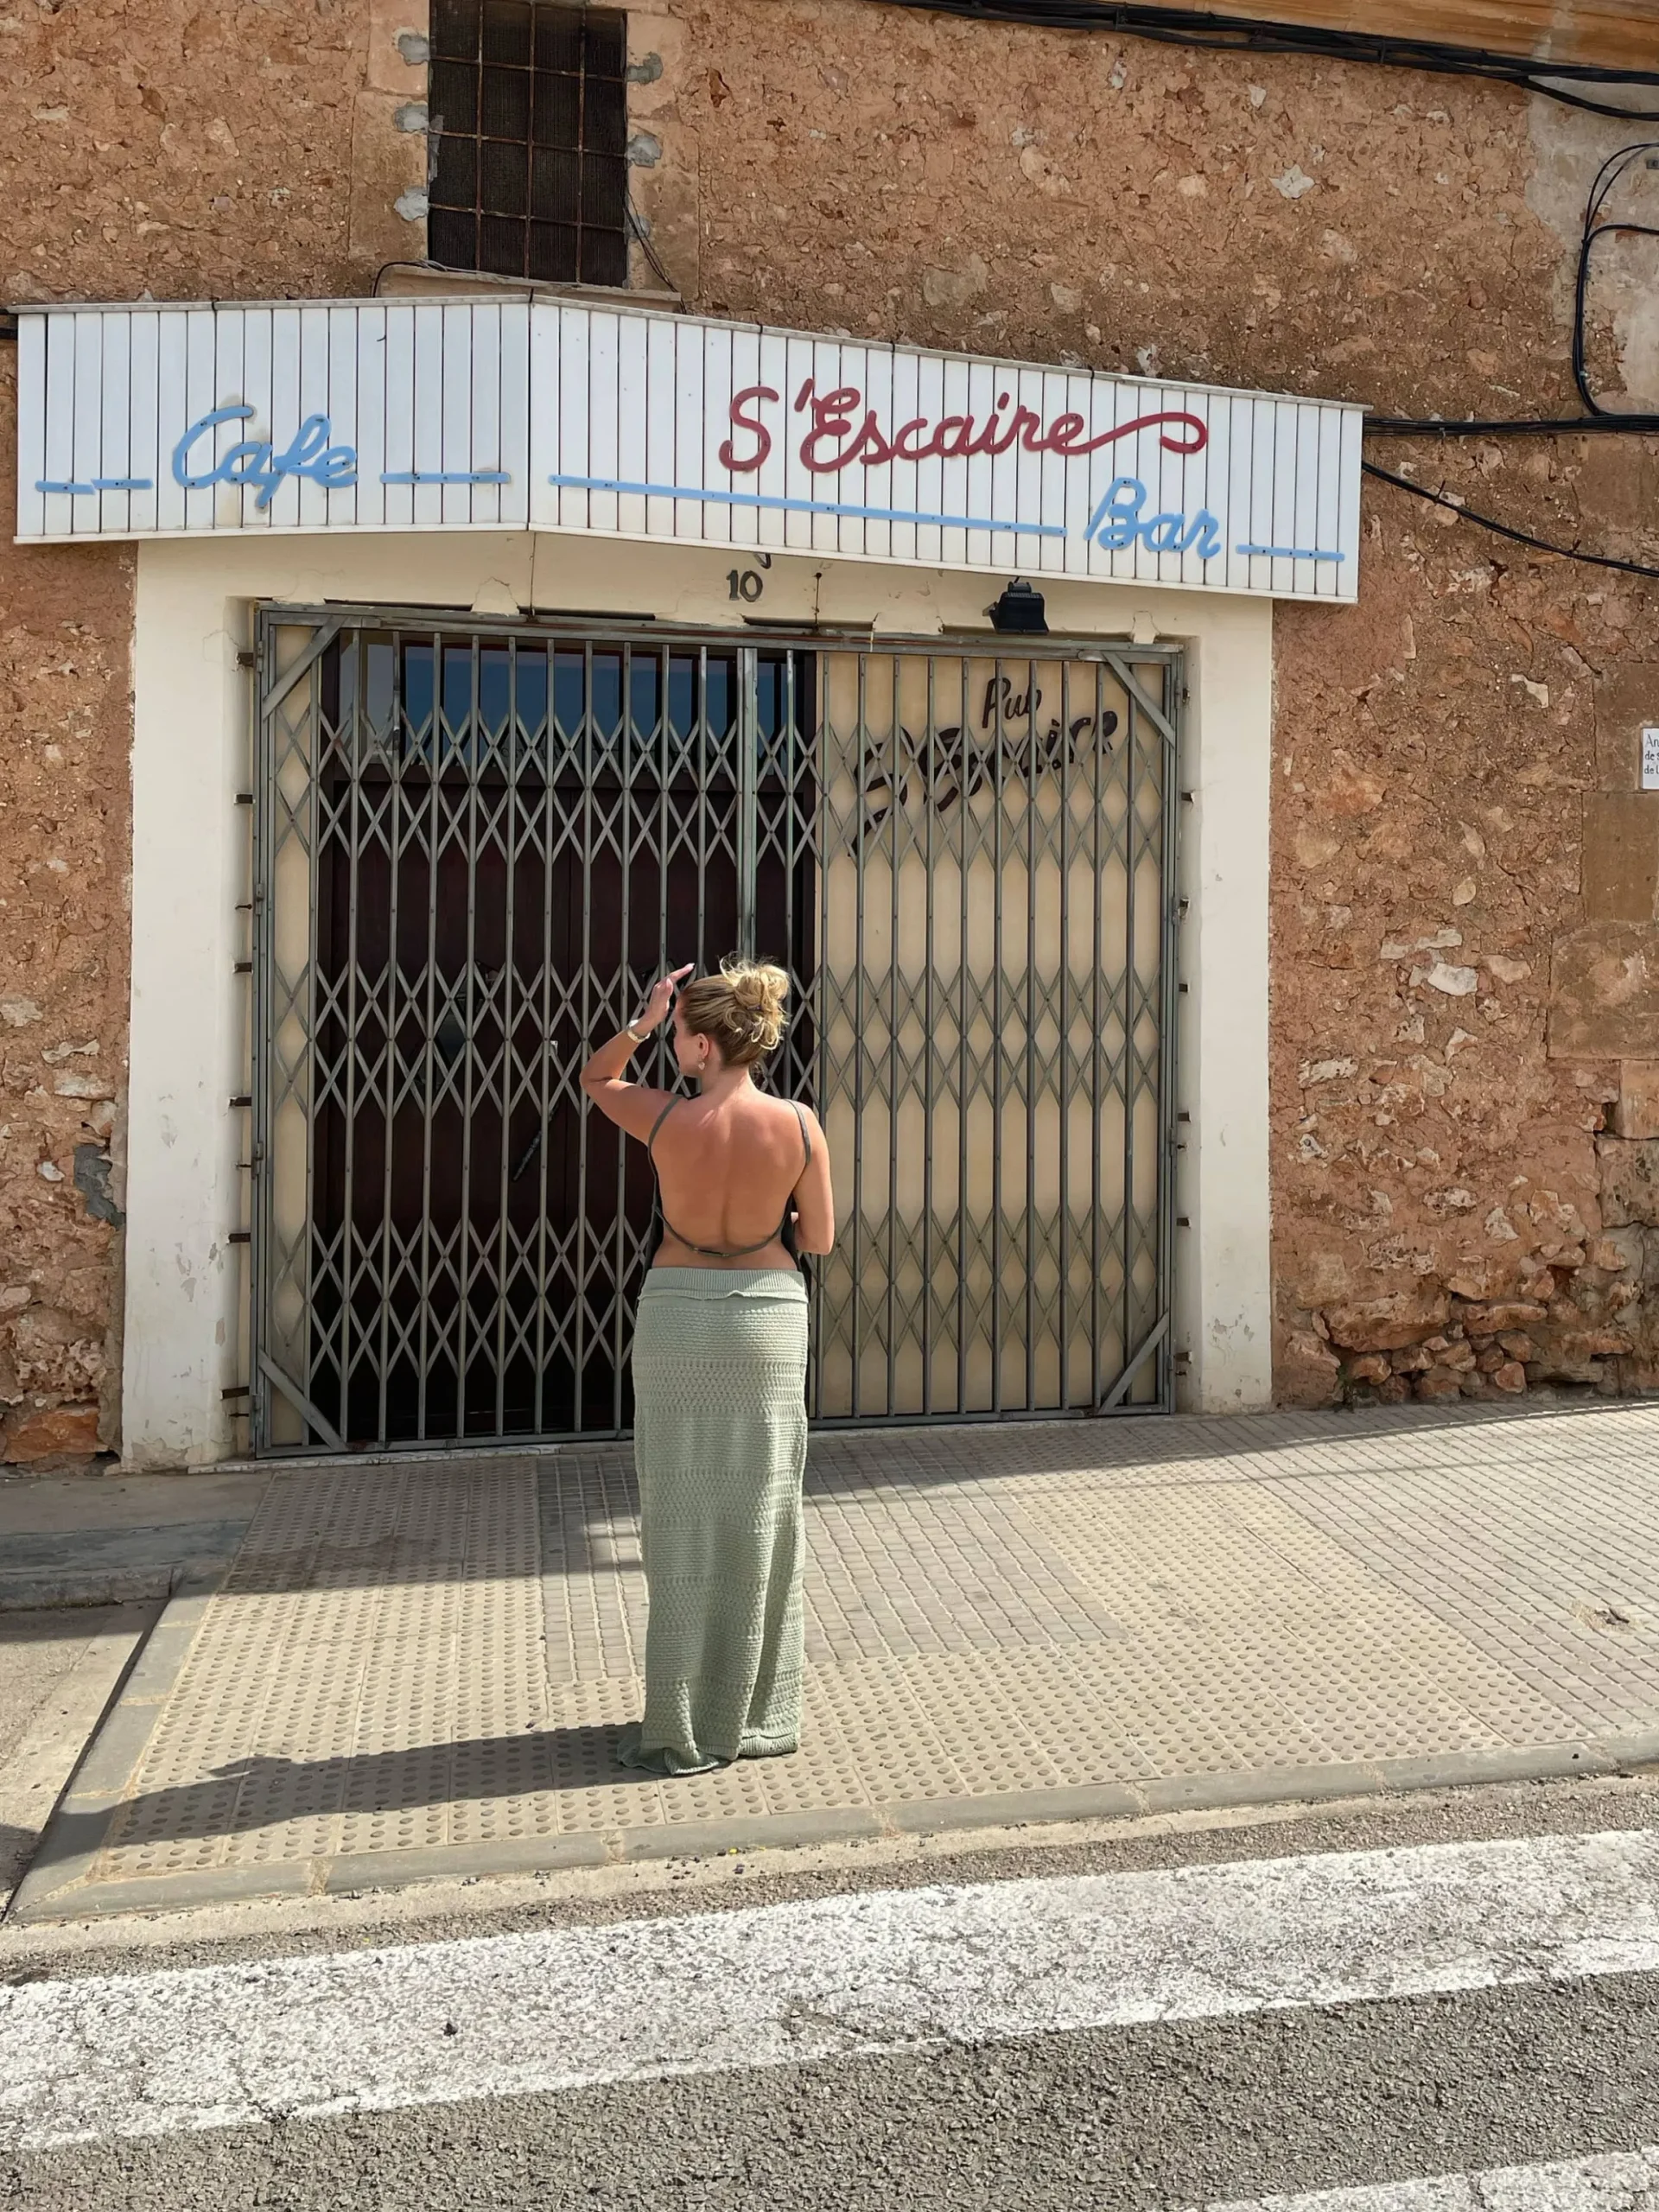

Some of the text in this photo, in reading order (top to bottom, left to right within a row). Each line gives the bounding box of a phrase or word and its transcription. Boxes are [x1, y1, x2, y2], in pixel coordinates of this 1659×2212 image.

[172, 405, 359, 509] Cafe
[718, 378, 1209, 474] S'Escaire
[1084, 477, 1221, 560] Bar
[725, 569, 764, 603] 10
[982, 677, 1042, 729] Pub
